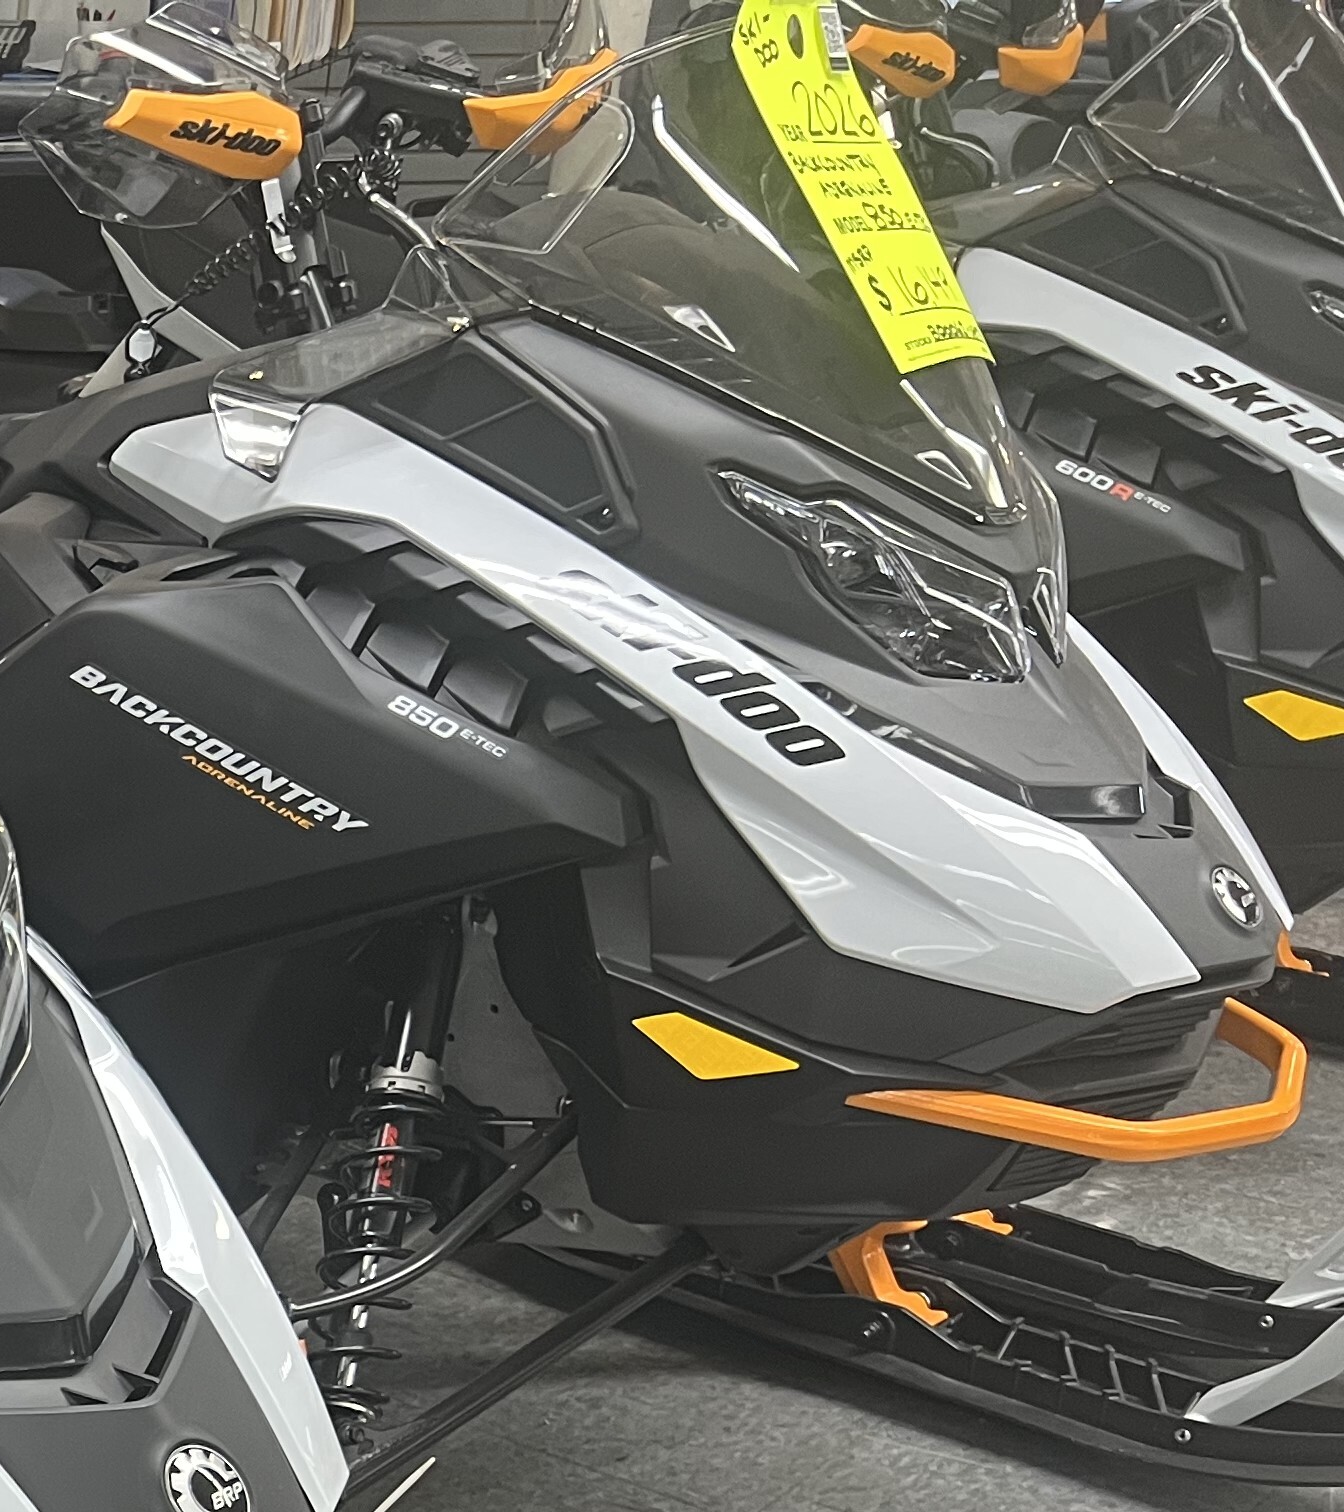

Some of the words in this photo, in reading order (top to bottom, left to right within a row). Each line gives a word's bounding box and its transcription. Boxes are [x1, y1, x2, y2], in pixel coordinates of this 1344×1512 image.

[170, 118, 282, 156] ski-doo
[791, 81, 876, 138] 2026
[861, 201, 905, 231] 850
[69, 664, 370, 832] BACKCOUNTRY
[387, 695, 460, 739] 850
[459, 728, 507, 758] E-TEC
[181, 754, 316, 831] ADRENALINE
[211, 1481, 244, 1511] BRP
